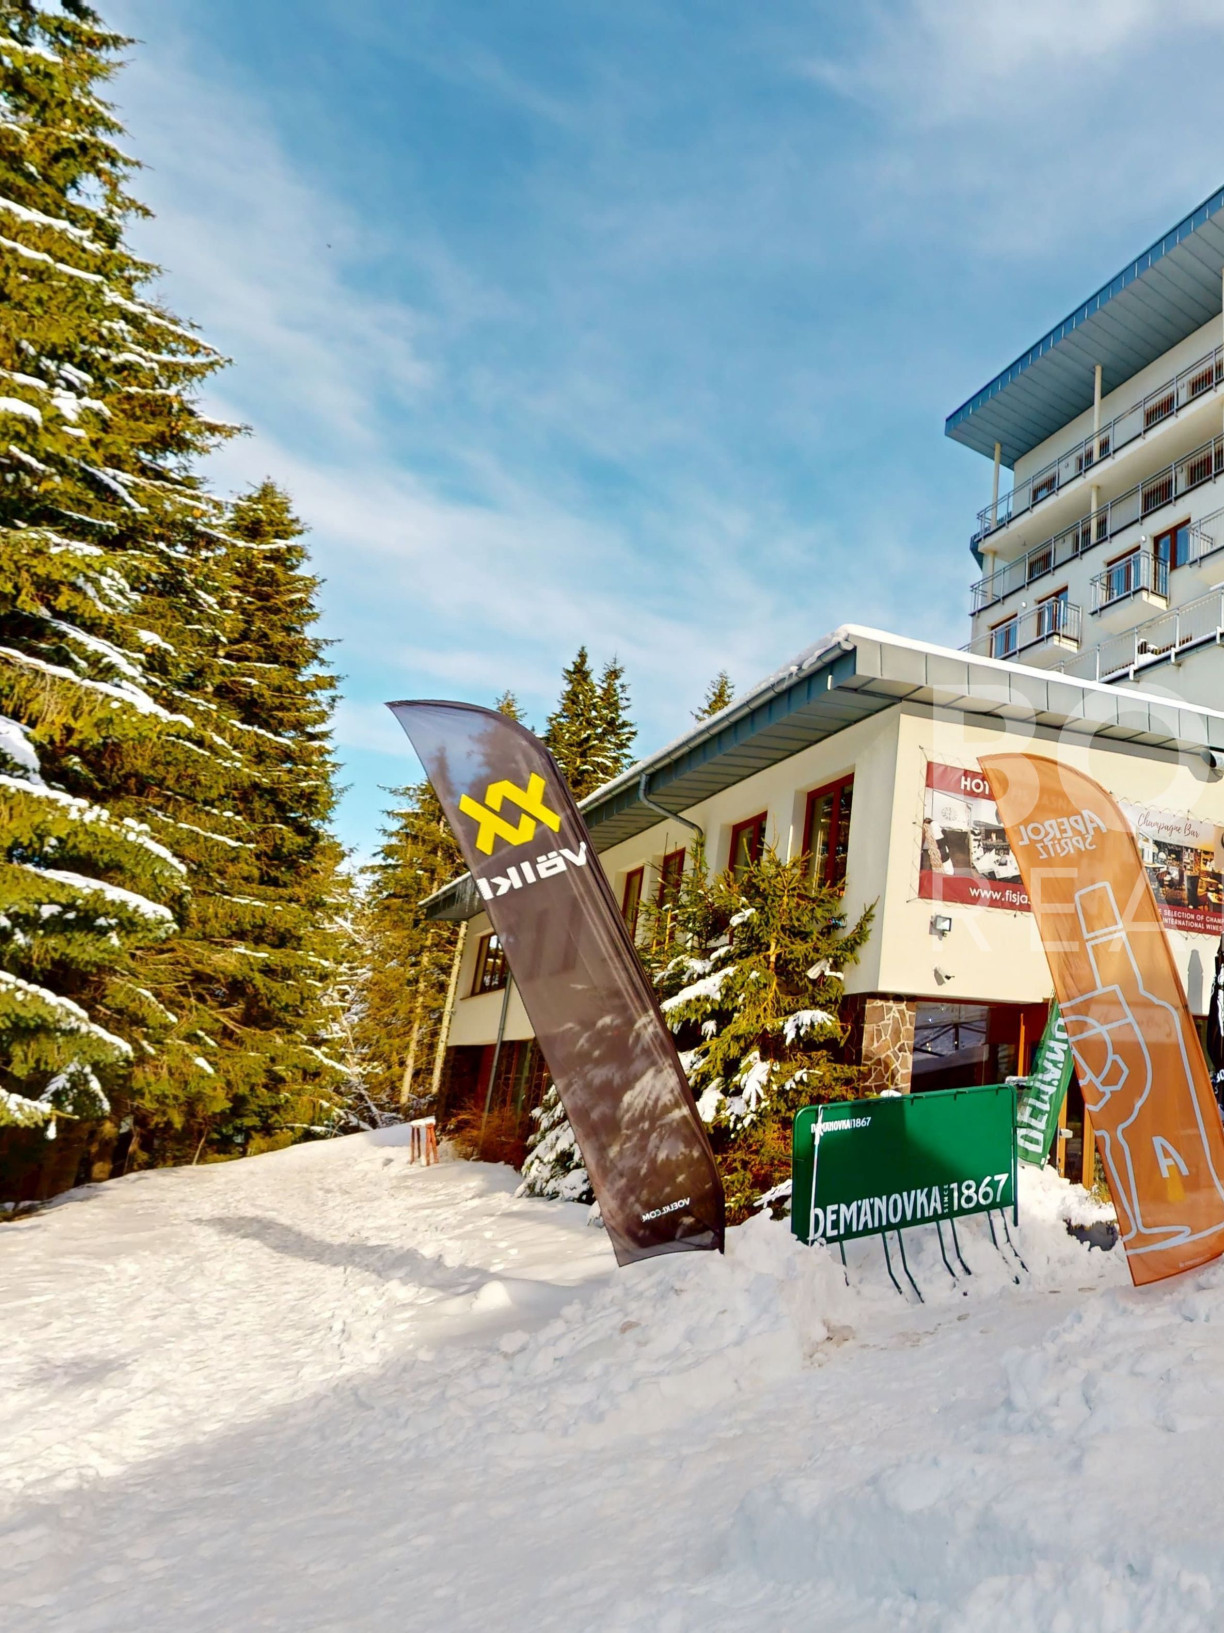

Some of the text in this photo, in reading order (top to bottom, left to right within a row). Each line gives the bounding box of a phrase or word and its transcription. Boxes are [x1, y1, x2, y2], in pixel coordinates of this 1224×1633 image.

[1137, 811, 1200, 839] Champagne Bar
[1163, 908, 1195, 920] SELECTION
[1205, 923, 1223, 931] WINES
[950, 1172, 1009, 1211] 1867
